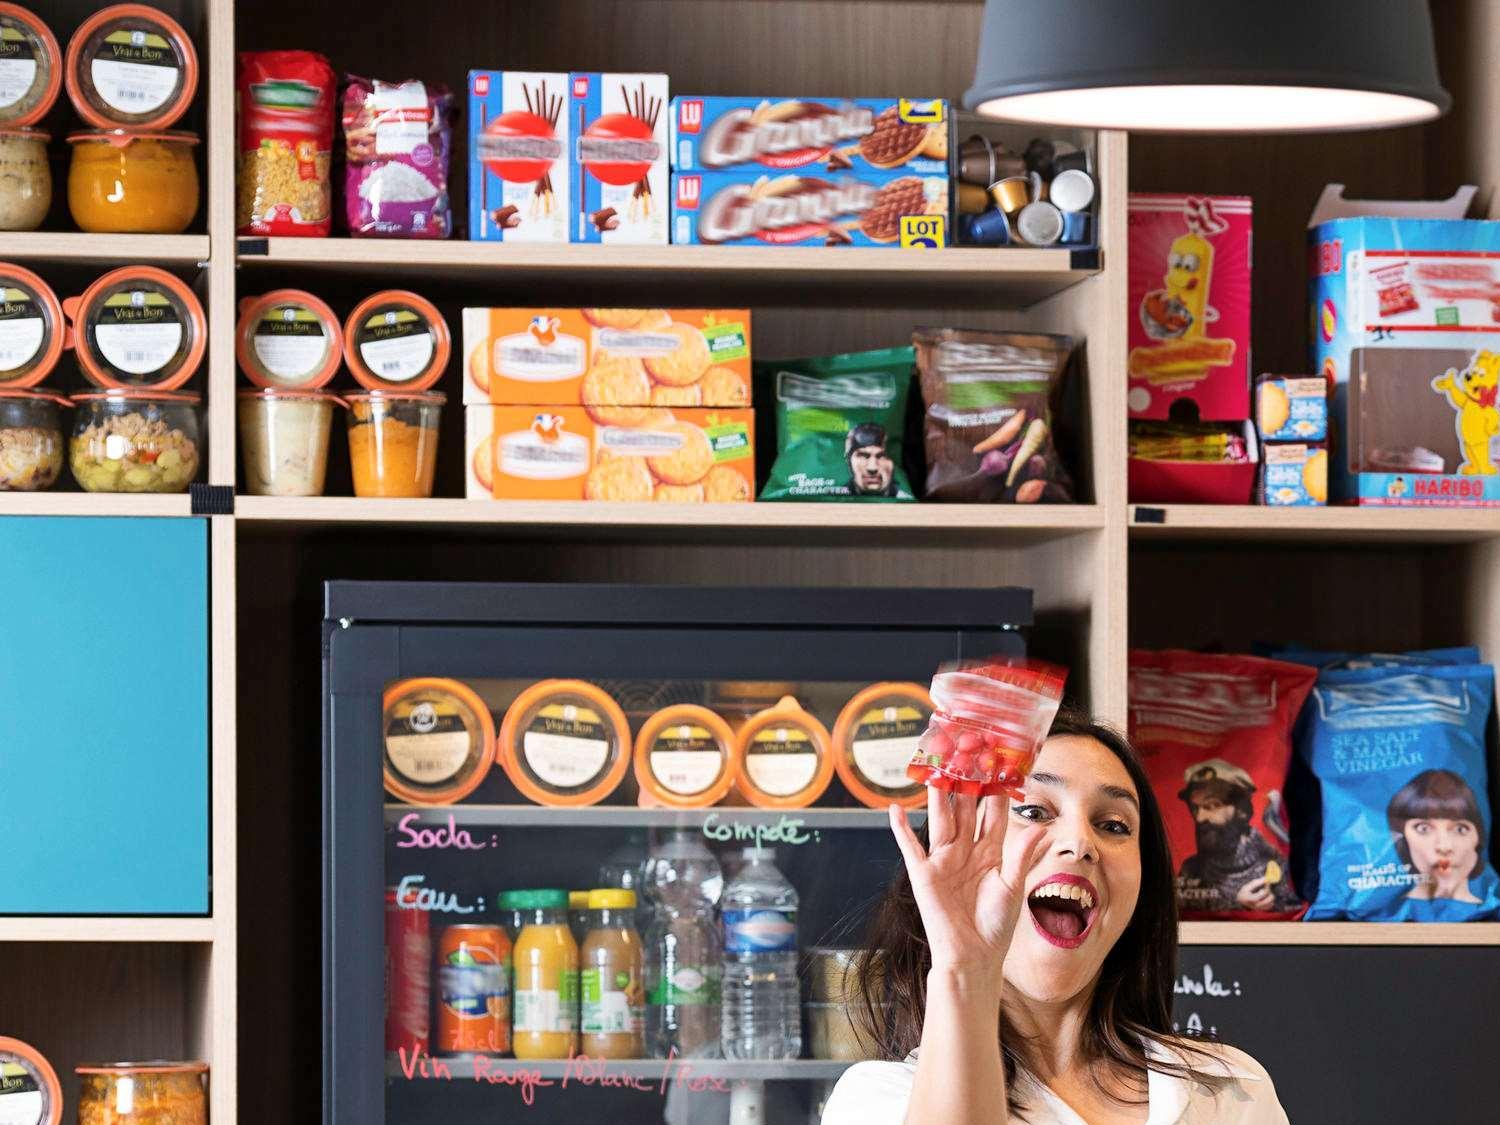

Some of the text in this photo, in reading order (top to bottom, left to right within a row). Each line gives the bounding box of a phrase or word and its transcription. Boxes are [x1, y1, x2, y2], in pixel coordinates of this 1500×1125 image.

[907, 221, 939, 235] LOT
[1415, 480, 1484, 497] HARIBO
[1331, 729, 1421, 746] SEA SALT
[1353, 742, 1408, 759] MALT
[1334, 752, 1424, 774] VINEGAR
[398, 1043, 450, 1080] Vin
[473, 1055, 554, 1105] Rouge
[576, 1053, 653, 1092] Blanc
